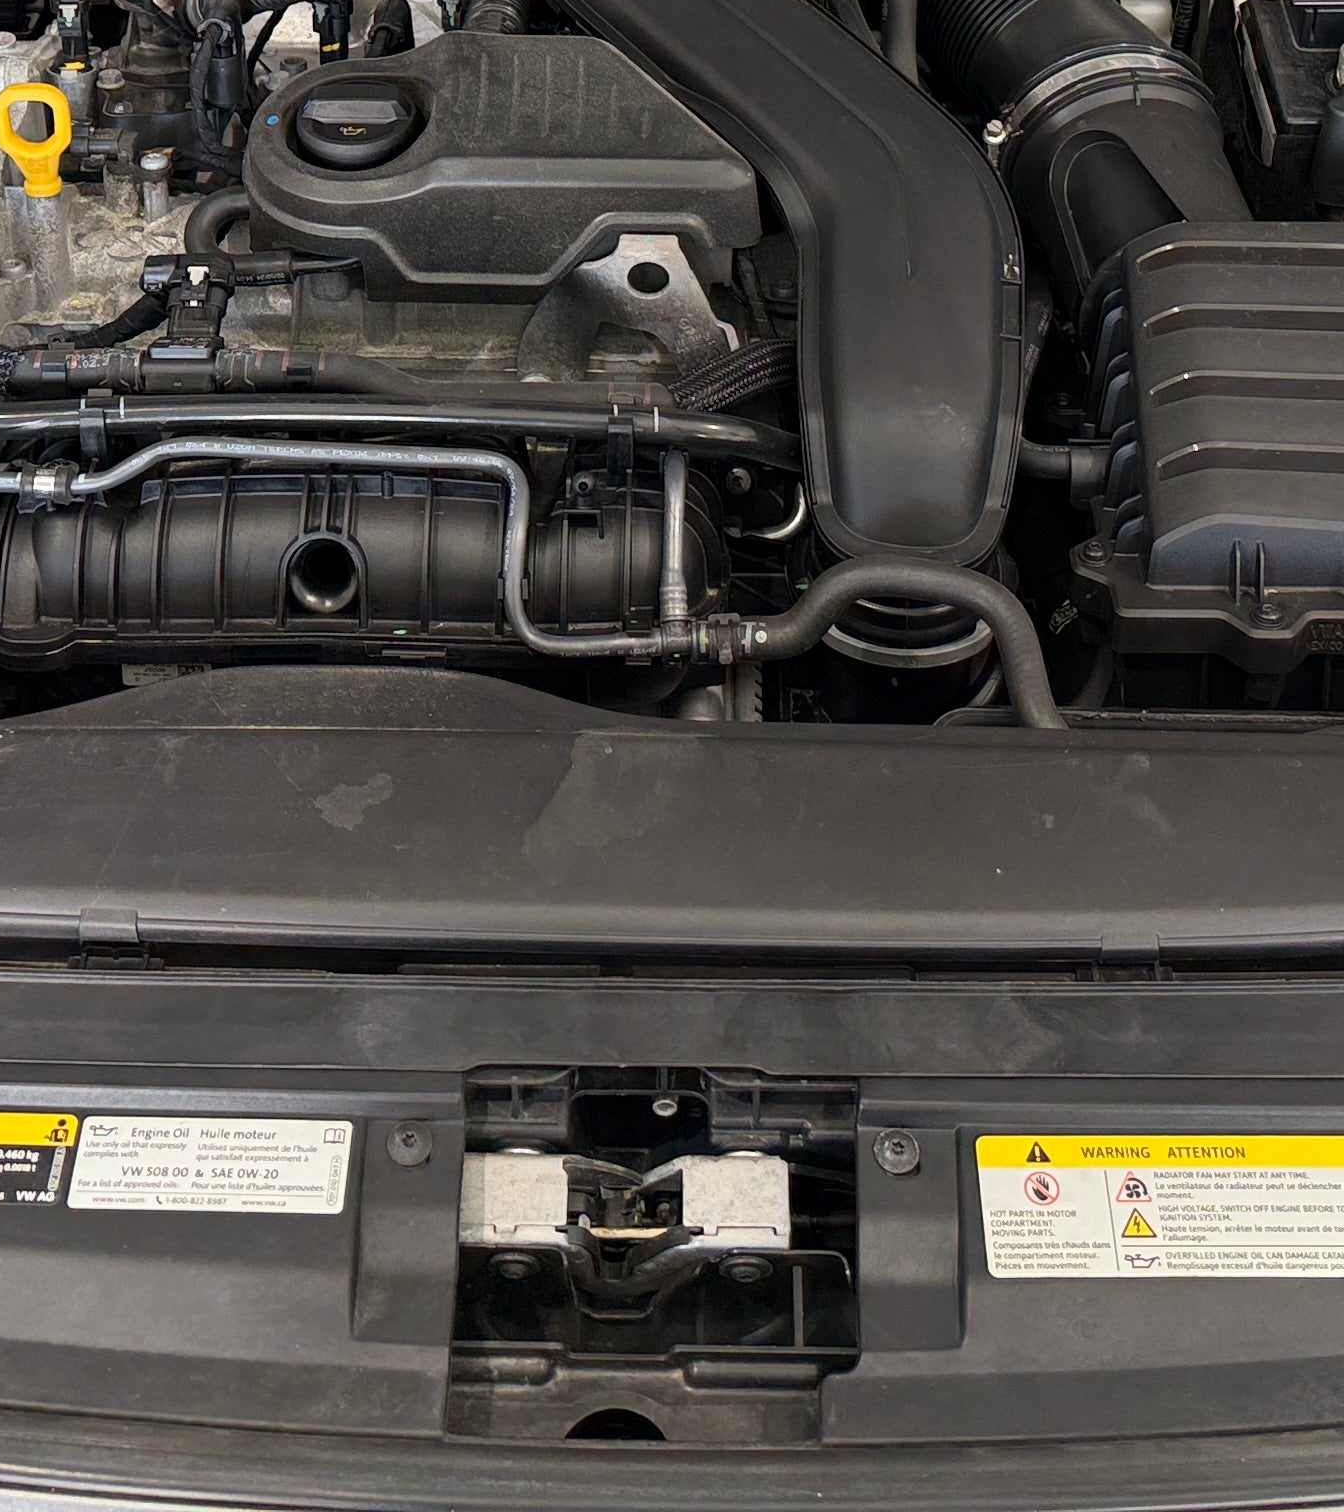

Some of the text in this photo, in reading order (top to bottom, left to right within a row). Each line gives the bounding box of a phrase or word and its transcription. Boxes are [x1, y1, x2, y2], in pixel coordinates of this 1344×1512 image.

[131, 1127, 277, 1141] Engine Oil Huile moteur
[85, 1140, 101, 1148] Use
[102, 1140, 120, 1151] only
[121, 1140, 131, 1149] oil
[132, 1140, 149, 1149] that
[281, 1144, 292, 1153] de
[26, 1150, 40, 1163] kg
[83, 1151, 118, 1159] complies
[1080, 1146, 1246, 1159] WARNING ATTENTION
[195, 1153, 209, 1162] qui
[121, 1165, 279, 1180] VW 508 00 & SAE 0W-20
[1153, 1171, 1194, 1179] RADIATOR
[1196, 1171, 1212, 1179] FAN
[1214, 1171, 1231, 1179] MAY
[1233, 1171, 1257, 1179] START
[1259, 1171, 1269, 1179] AT
[1270, 1171, 1288, 1179] ANY
[77, 1179, 91, 1187] For
[99, 1179, 111, 1187] list
[113, 1179, 122, 1187] of
[123, 1181, 161, 1190] approved
[191, 1181, 209, 1190] Pour
[211, 1183, 226, 1191] une
[228, 1182, 244, 1191] liste
[1155, 1181, 1165, 1190] Le
[1167, 1181, 1211, 1190] ventilateur
[1213, 1181, 1224, 1190] de
[1226, 1181, 1263, 1190] radiateur
[1266, 1183, 1285, 1191] peut
[15, 1190, 37, 1201] VW
[36, 1191, 56, 1202] AG
[1158, 1205, 1179, 1213] HIGH
[1220, 1205, 1252, 1213] SWITCH
[1253, 1205, 1269, 1213] OFF
[1271, 1204, 1301, 1213] ENGINE
[1303, 1204, 1334, 1213] BEFORE
[989, 1210, 1077, 1218] HOT PARTS IN MOTOR
[1159, 1213, 1197, 1221] IGNITION
[992, 1229, 1026, 1237] MOVING
[1161, 1224, 1187, 1233] Haute
[1321, 1225, 1332, 1233] de
[992, 1240, 1111, 1250] Composants très chauds dans
[1003, 1252, 1064, 1261] compartiment
[1164, 1251, 1216, 1260] OVERFILLED
[1217, 1251, 1248, 1260] ENGINE
[1250, 1251, 1264, 1260] OIL
[1266, 1251, 1284, 1259] CAN
[1285, 1251, 1320, 1259] DAMAGE
[995, 1261, 1022, 1269] Pièces
[1166, 1262, 1220, 1271] Remplissage
[1220, 1262, 1254, 1270] excessif
[1285, 1262, 1329, 1271] dangereux
